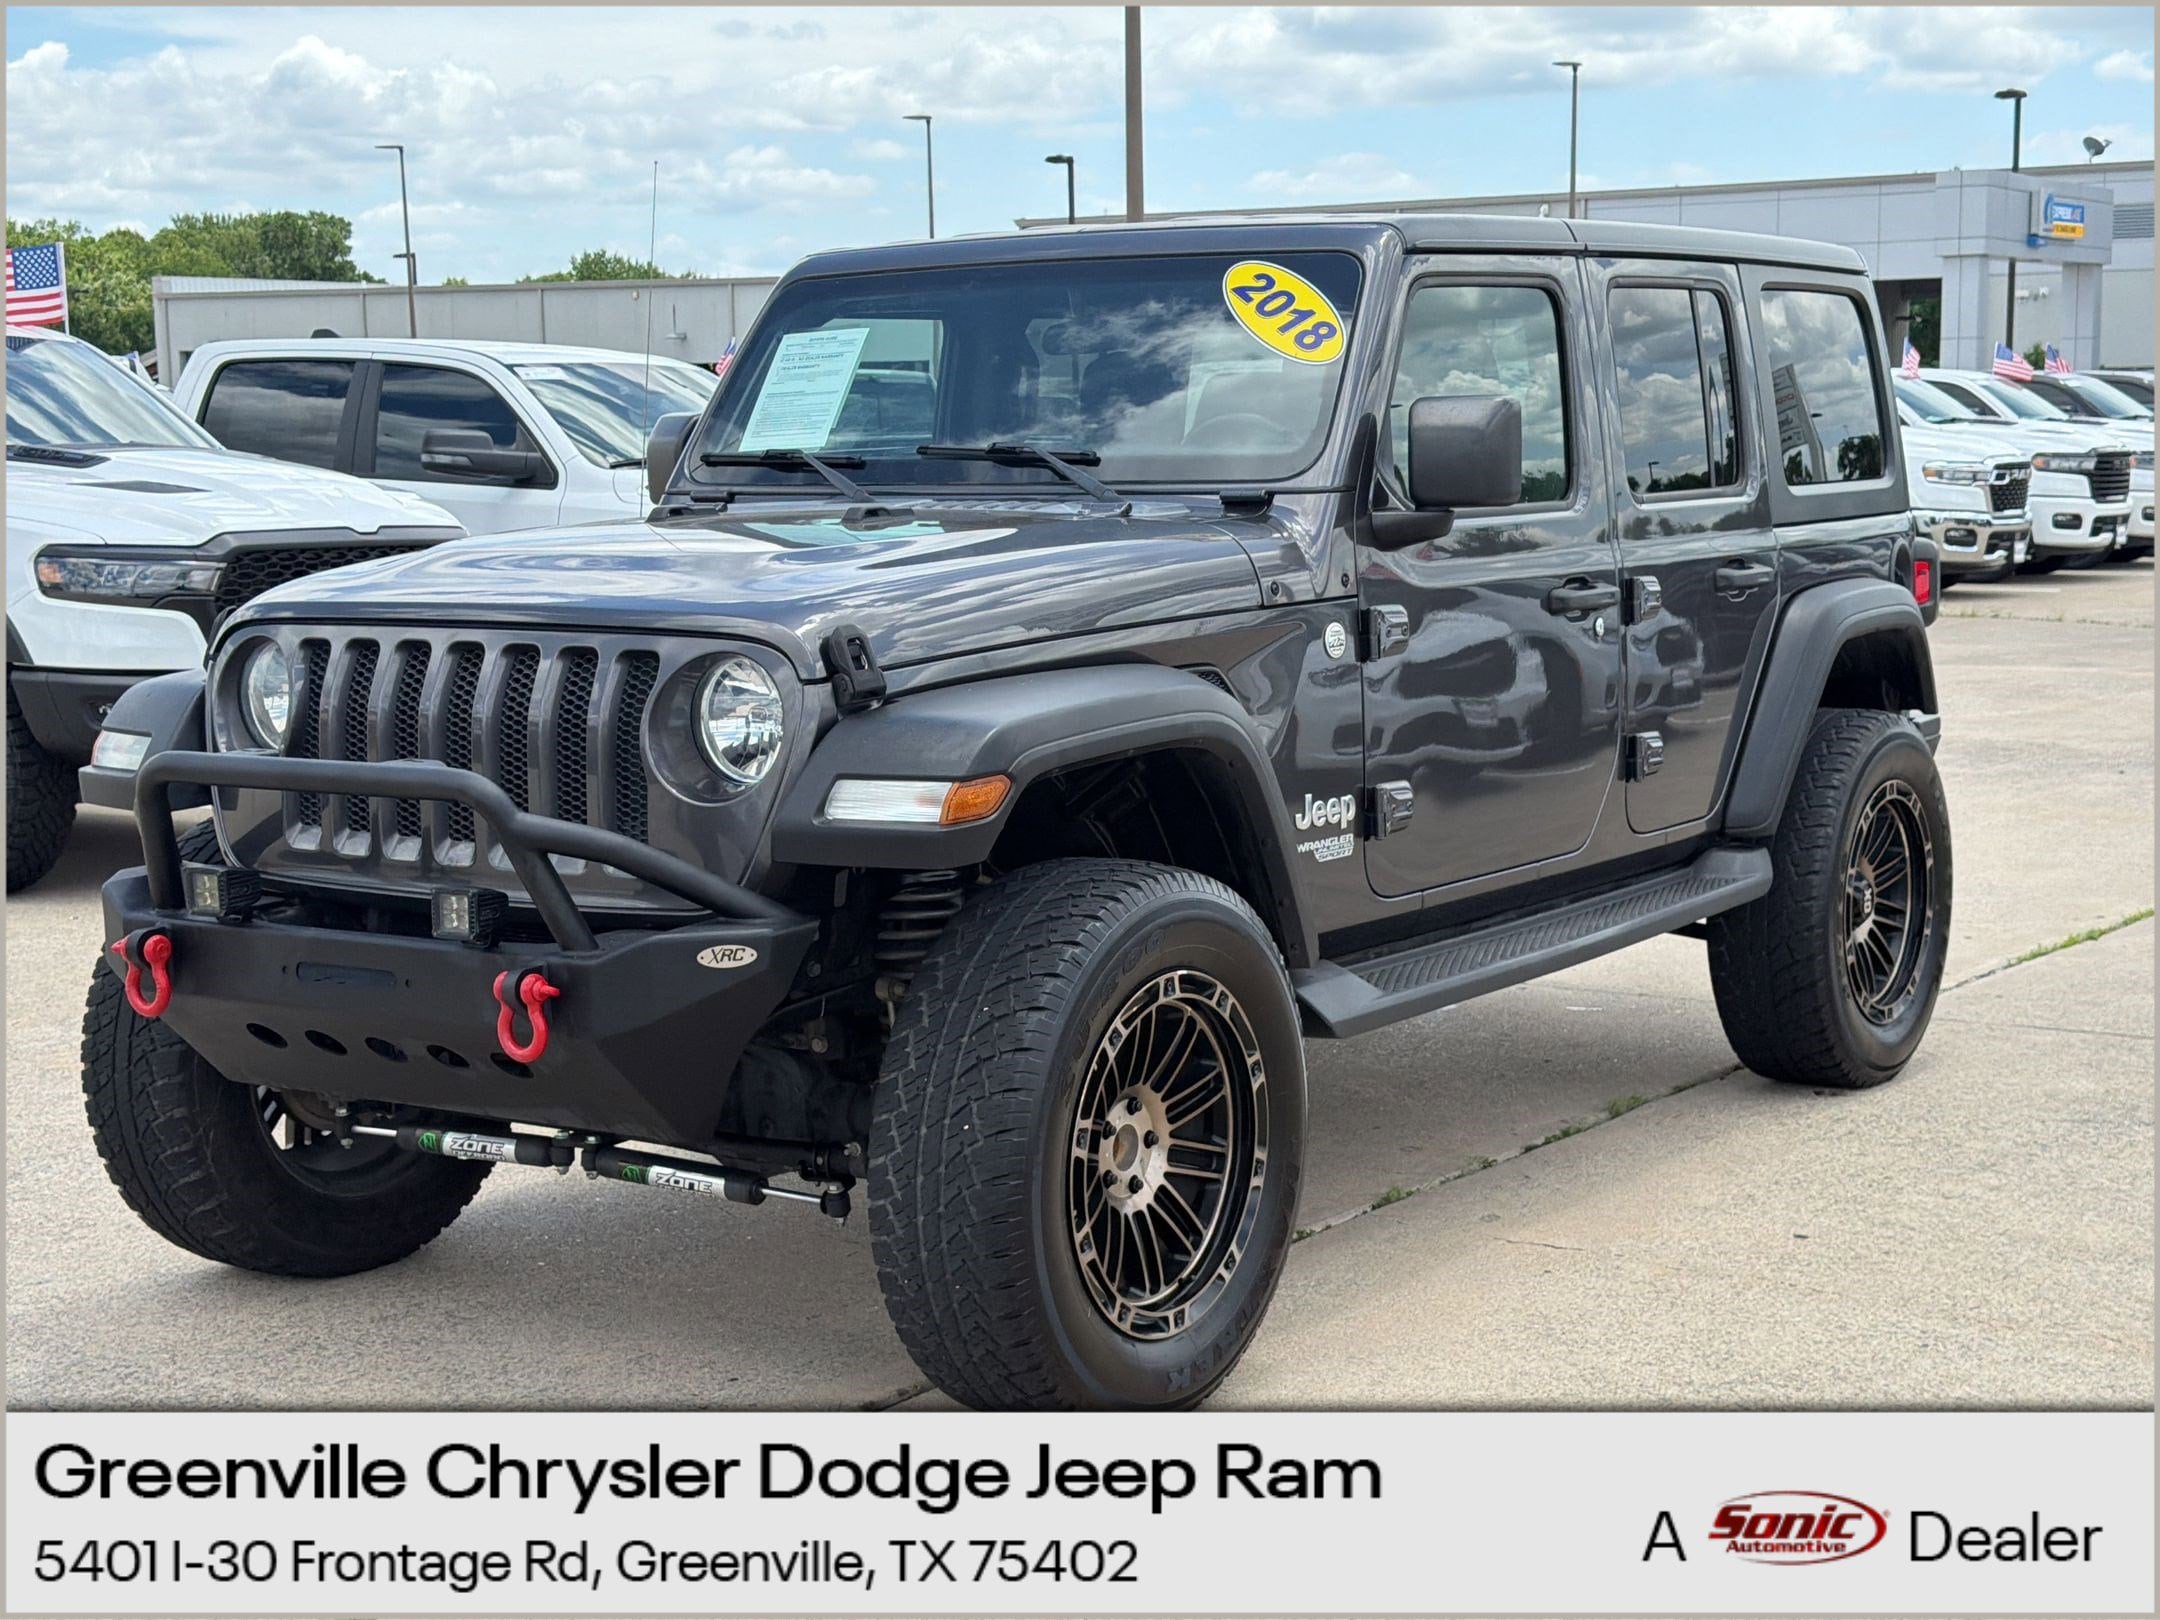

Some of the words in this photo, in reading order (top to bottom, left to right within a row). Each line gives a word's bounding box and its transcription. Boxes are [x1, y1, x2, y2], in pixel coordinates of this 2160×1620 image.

[1231, 273, 1338, 351] 2018
[1295, 793, 1356, 830] Jeep
[1296, 833, 1354, 854] WRANGLER
[707, 947, 746, 964] XRC
[449, 1136, 504, 1156] ZONE
[656, 1171, 712, 1194] ZONE
